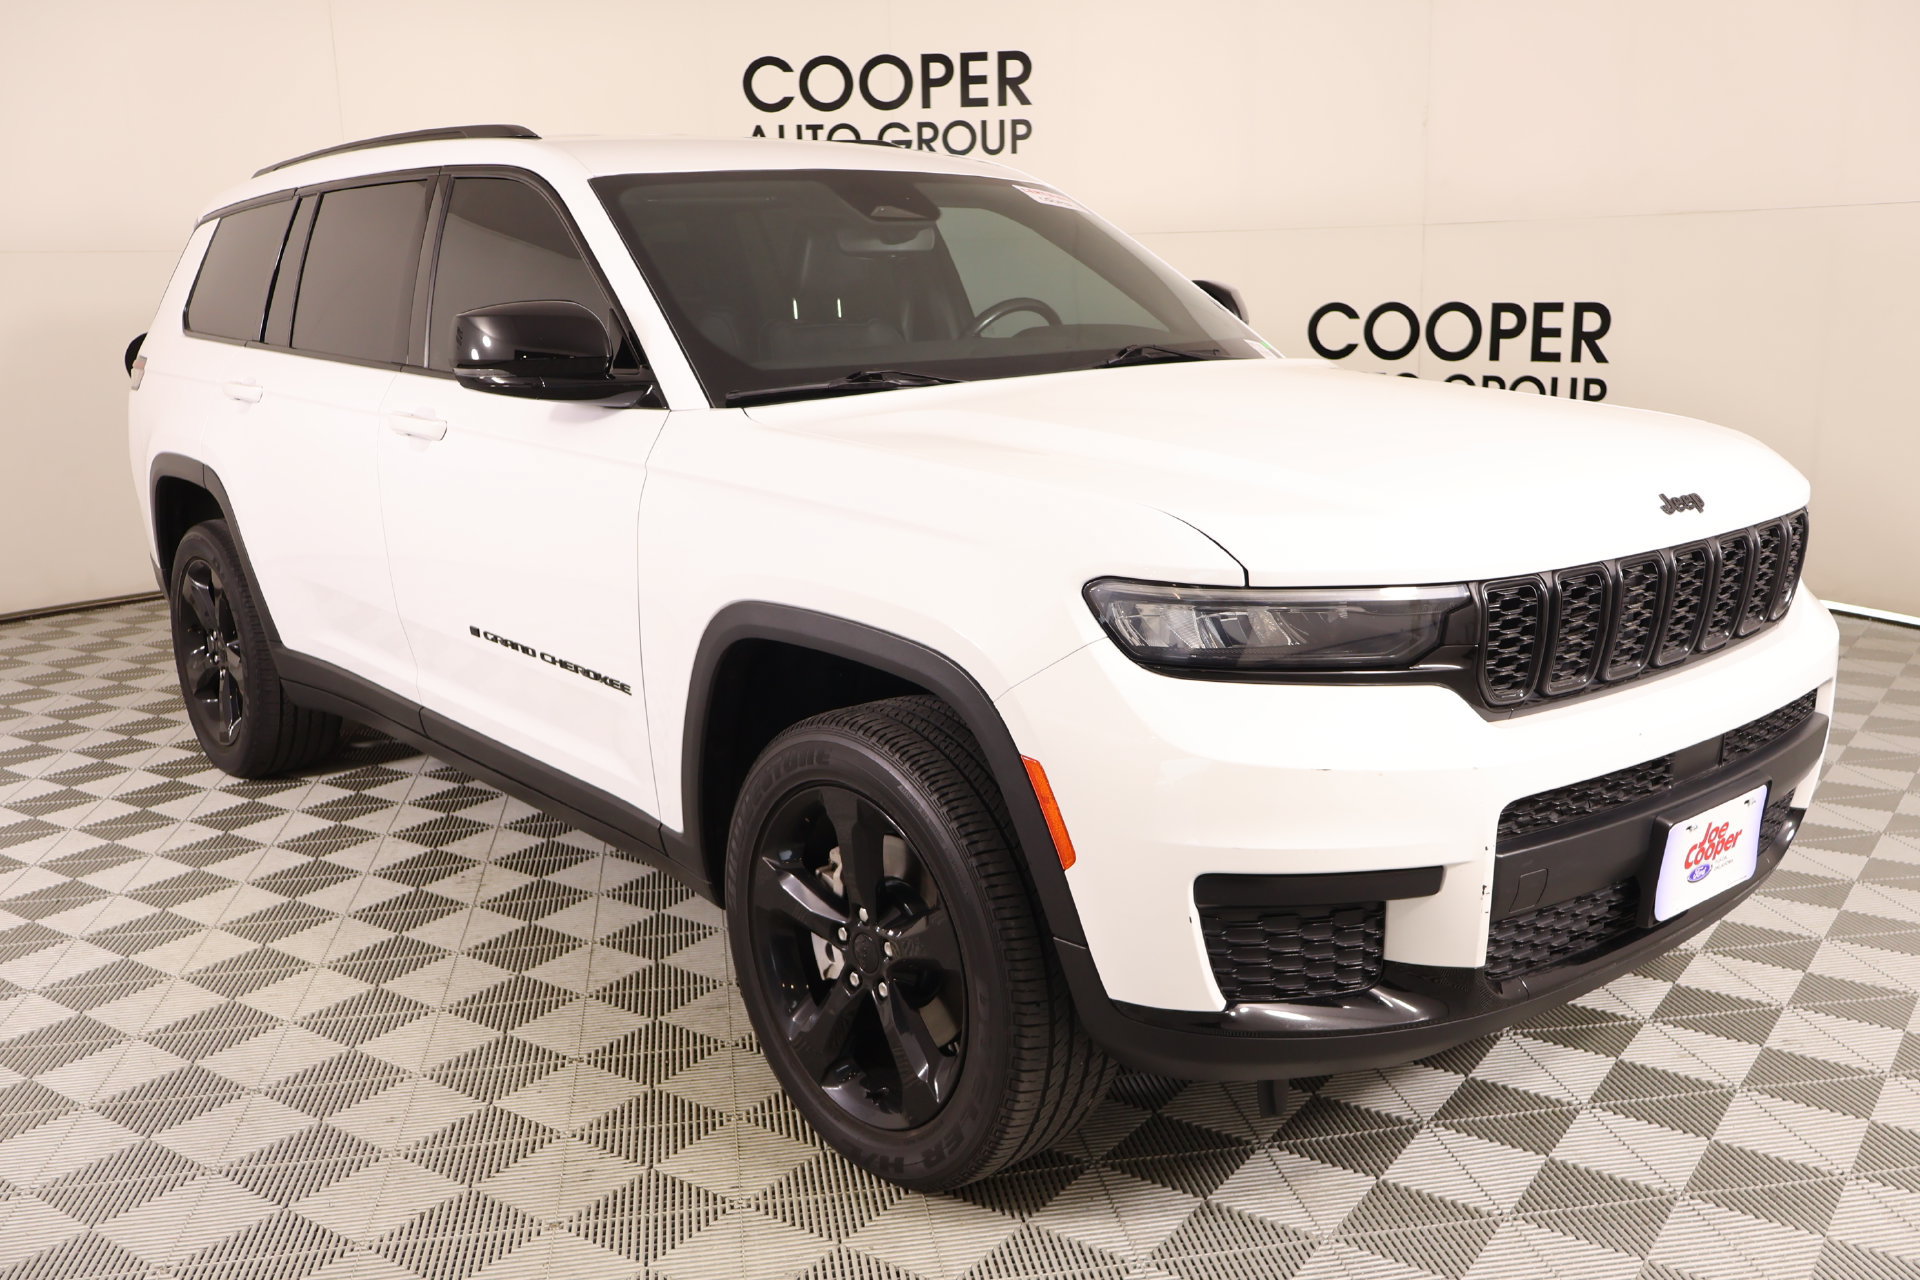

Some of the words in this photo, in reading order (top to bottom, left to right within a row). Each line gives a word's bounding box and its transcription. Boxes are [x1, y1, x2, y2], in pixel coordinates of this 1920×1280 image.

[742, 50, 1033, 113] COOPER
[877, 118, 1033, 156] GROUP
[1307, 301, 1612, 364] COOPER
[1658, 493, 1705, 516] Jeep
[483, 631, 537, 658] GRAND
[540, 651, 632, 696] CHEROKEE
[1684, 829, 1743, 870] Cooper
[1698, 821, 1729, 849] Joe
